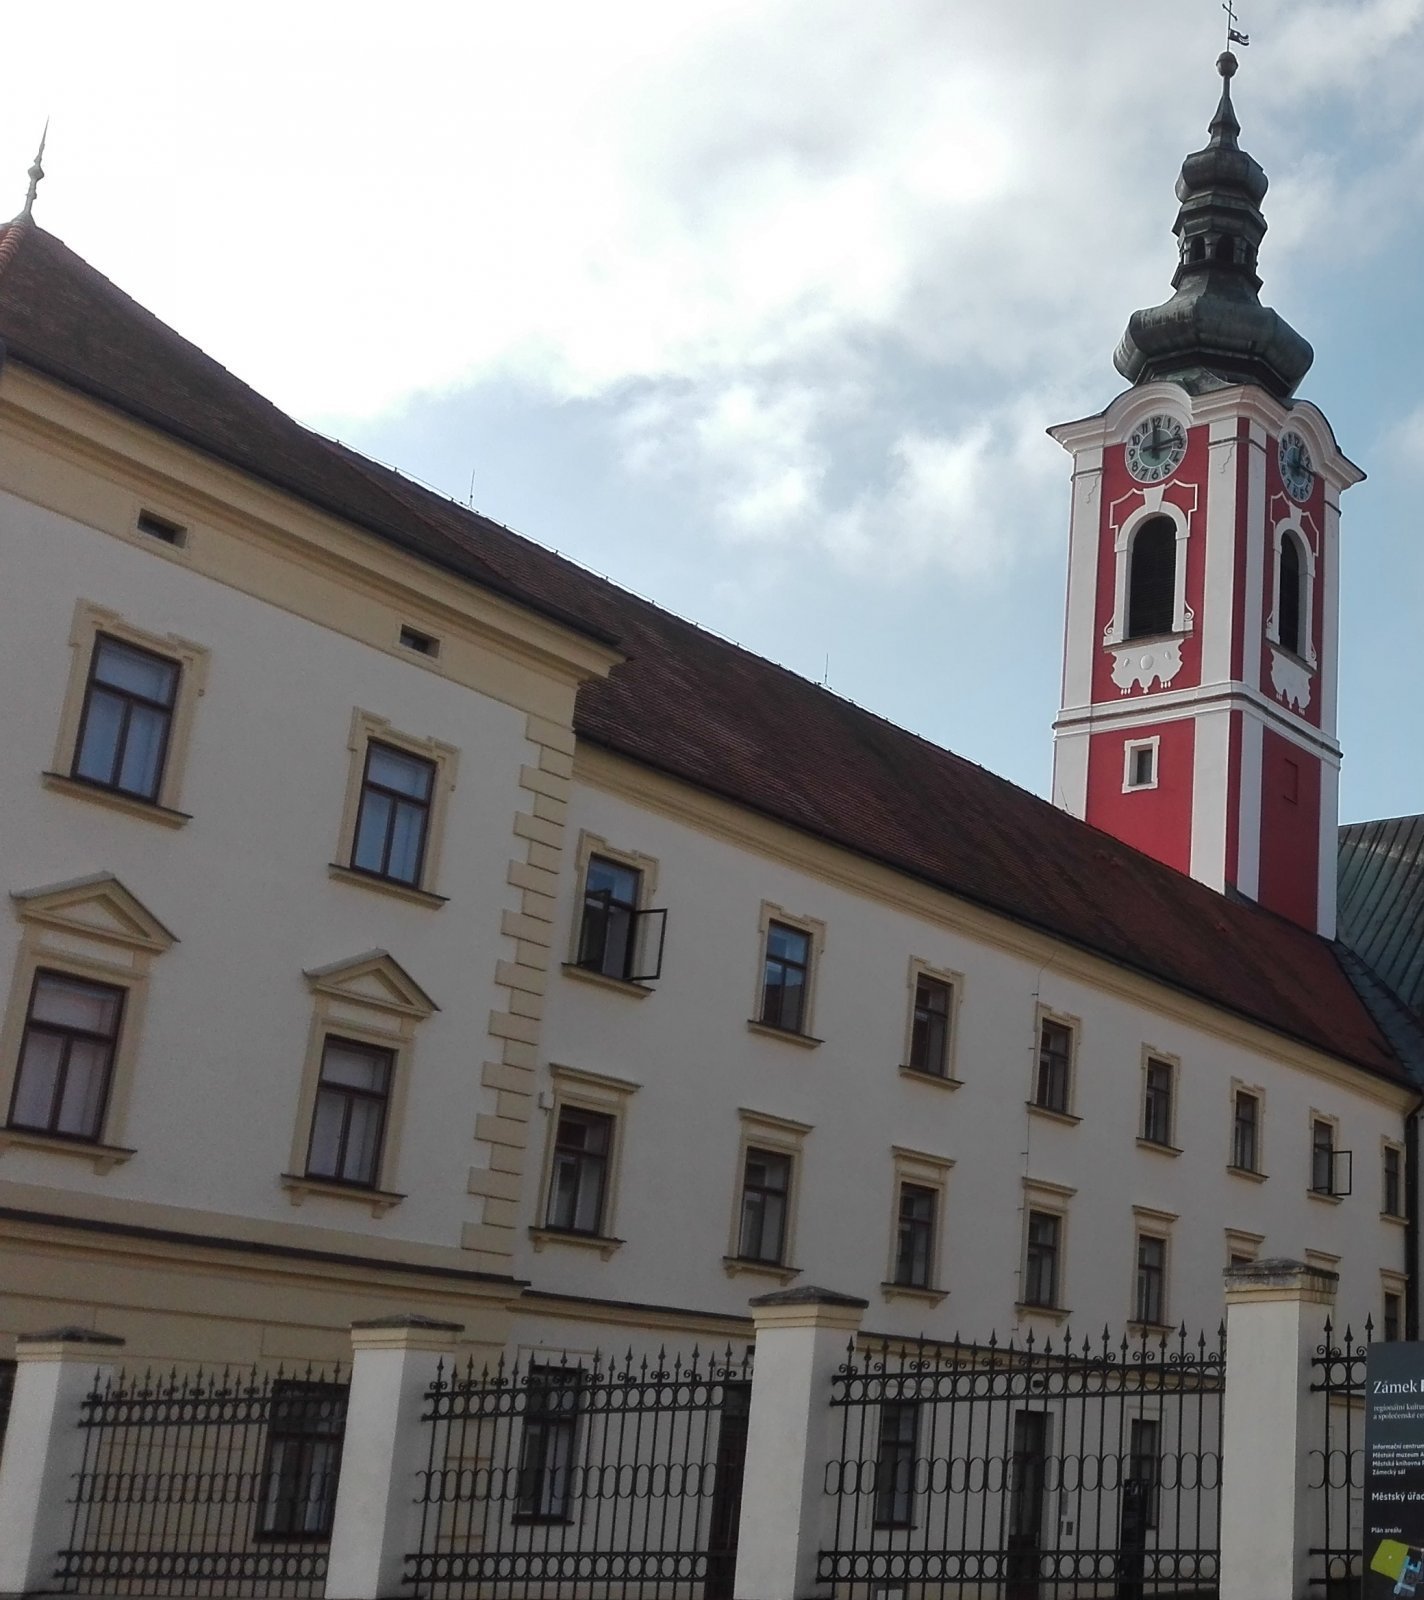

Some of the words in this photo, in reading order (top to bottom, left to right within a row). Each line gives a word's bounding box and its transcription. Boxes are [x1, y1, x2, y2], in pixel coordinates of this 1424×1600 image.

[1152, 417, 1161, 428] 12
[1141, 423, 1148, 434] 11
[1174, 425, 1180, 436] 2
[1132, 435, 1140, 446] 10
[1129, 449, 1135, 459] 9
[1132, 461, 1138, 472] 8
[1164, 464, 1170, 475] 5
[1140, 466, 1148, 480] 7
[1152, 469, 1158, 480] 6
[1373, 1379, 1417, 1393] Zámek
[1372, 1492, 1405, 1502] Městský
